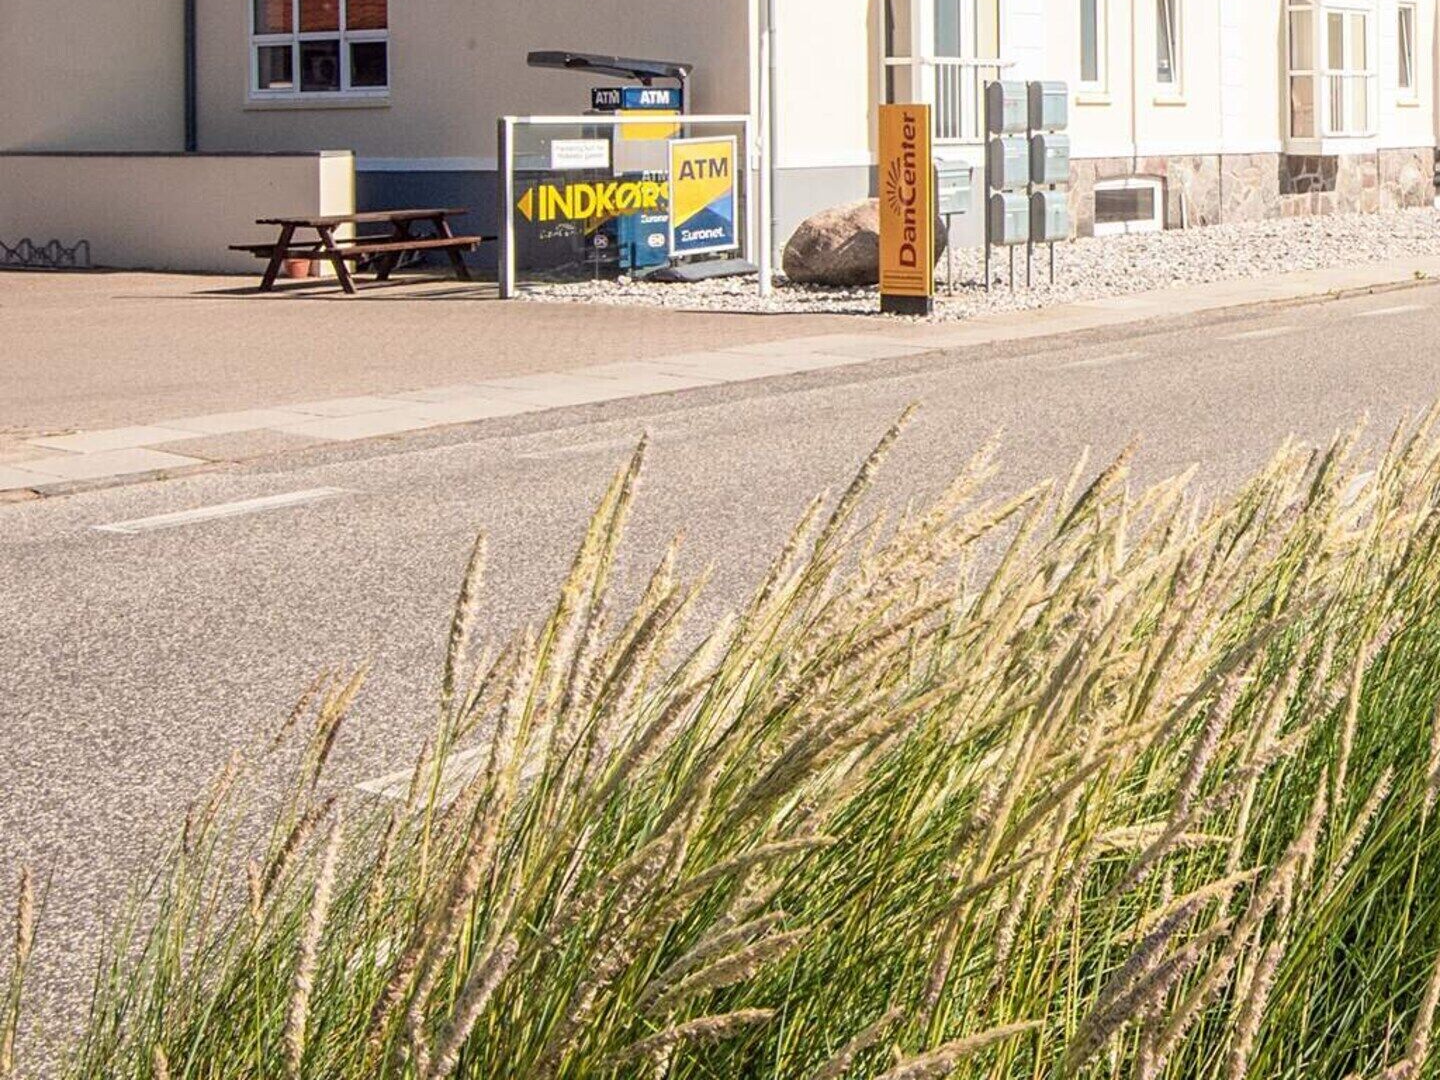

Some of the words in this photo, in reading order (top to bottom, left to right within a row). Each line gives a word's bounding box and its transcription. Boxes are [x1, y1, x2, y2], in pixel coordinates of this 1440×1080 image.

[595, 89, 620, 105] ATM
[640, 89, 670, 105] ATM
[678, 157, 728, 181] ATM
[898, 111, 917, 268] DanCenter
